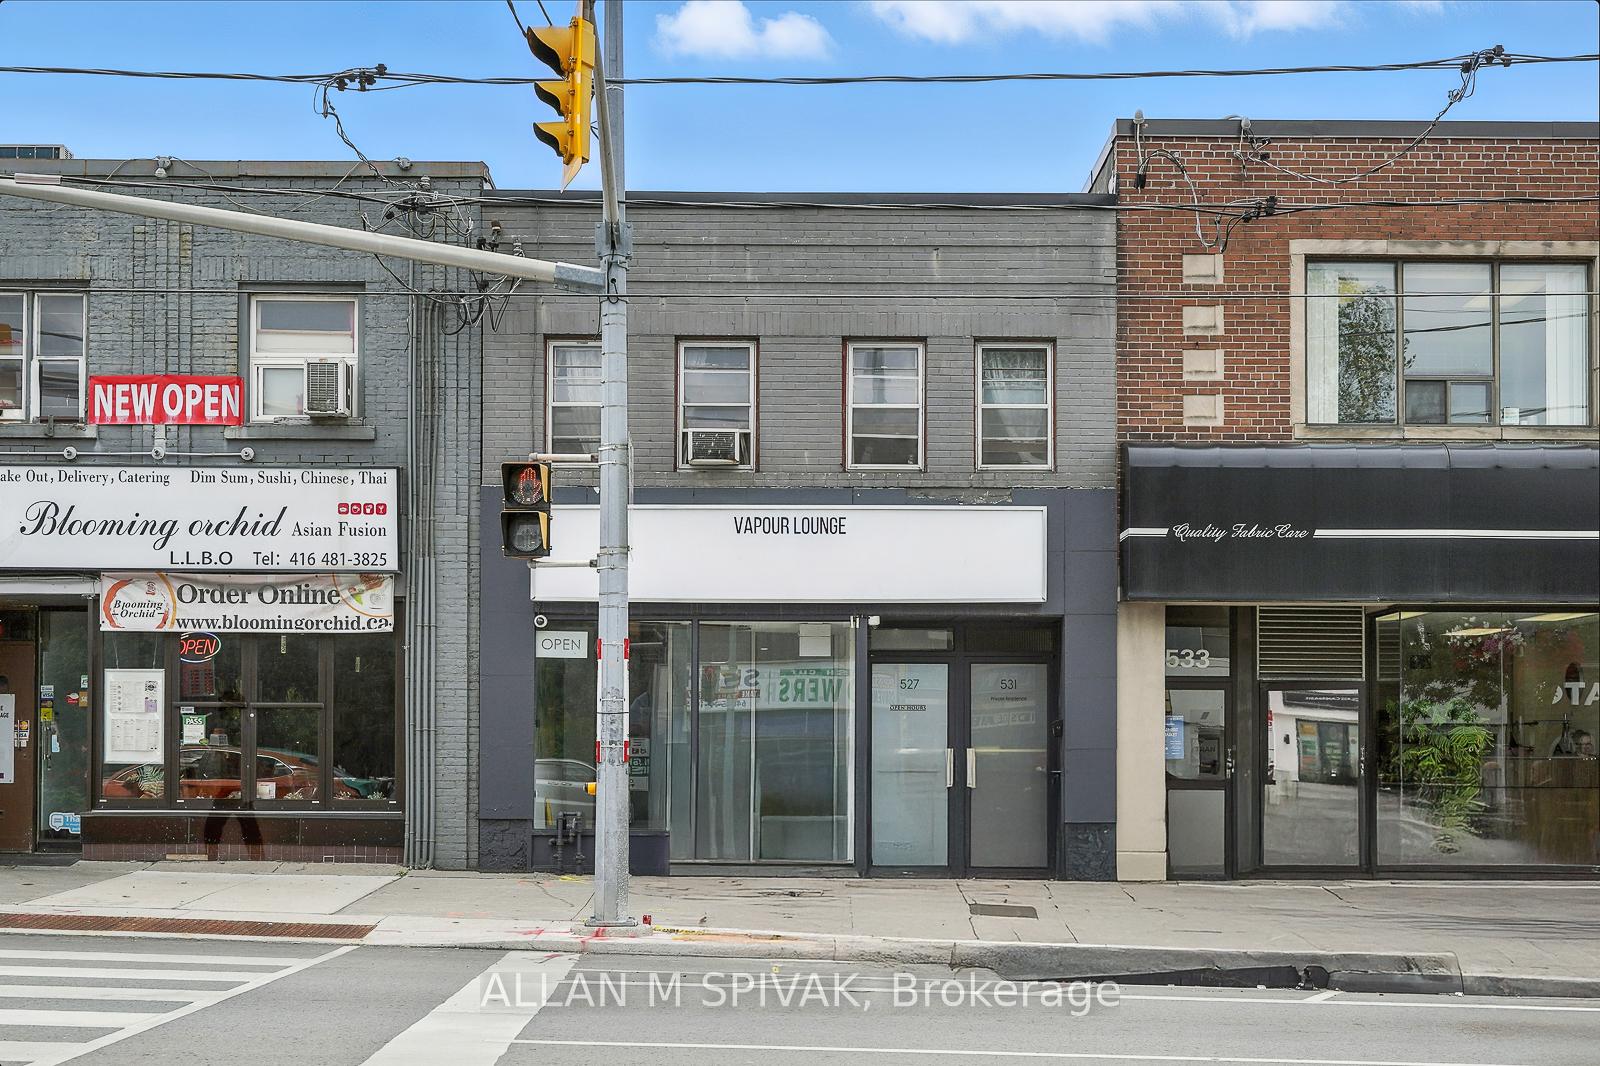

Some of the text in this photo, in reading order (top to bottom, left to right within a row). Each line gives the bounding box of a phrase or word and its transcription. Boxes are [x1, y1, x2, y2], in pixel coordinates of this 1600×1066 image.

[94, 383, 240, 418] NEW OPEN
[57, 470, 115, 486] Delivery,
[118, 470, 170, 486] Catering
[191, 470, 216, 483] Dim
[221, 470, 254, 485] Sum,
[257, 471, 297, 485] Sushi,
[301, 471, 355, 486] Chinese,
[358, 471, 387, 485] Thai
[19, 500, 288, 550] Blooming orchid
[291, 521, 387, 537] Asian Fusion
[734, 516, 847, 535] VAPOUR LOUNGE
[1172, 522, 1310, 542] Quality Fabric Care
[170, 551, 387, 567] L.L.B.O Tel: 416 481-3825
[176, 584, 252, 605] Order
[257, 584, 342, 606] Online
[120, 609, 156, 618] Orchid
[176, 614, 390, 631] www.bloomingorchid.ca
[541, 638, 581, 650] OPEN
[1165, 648, 1210, 669] 533
[900, 679, 920, 690] 527
[1000, 679, 1017, 690] 531
[185, 717, 203, 725] PASS
